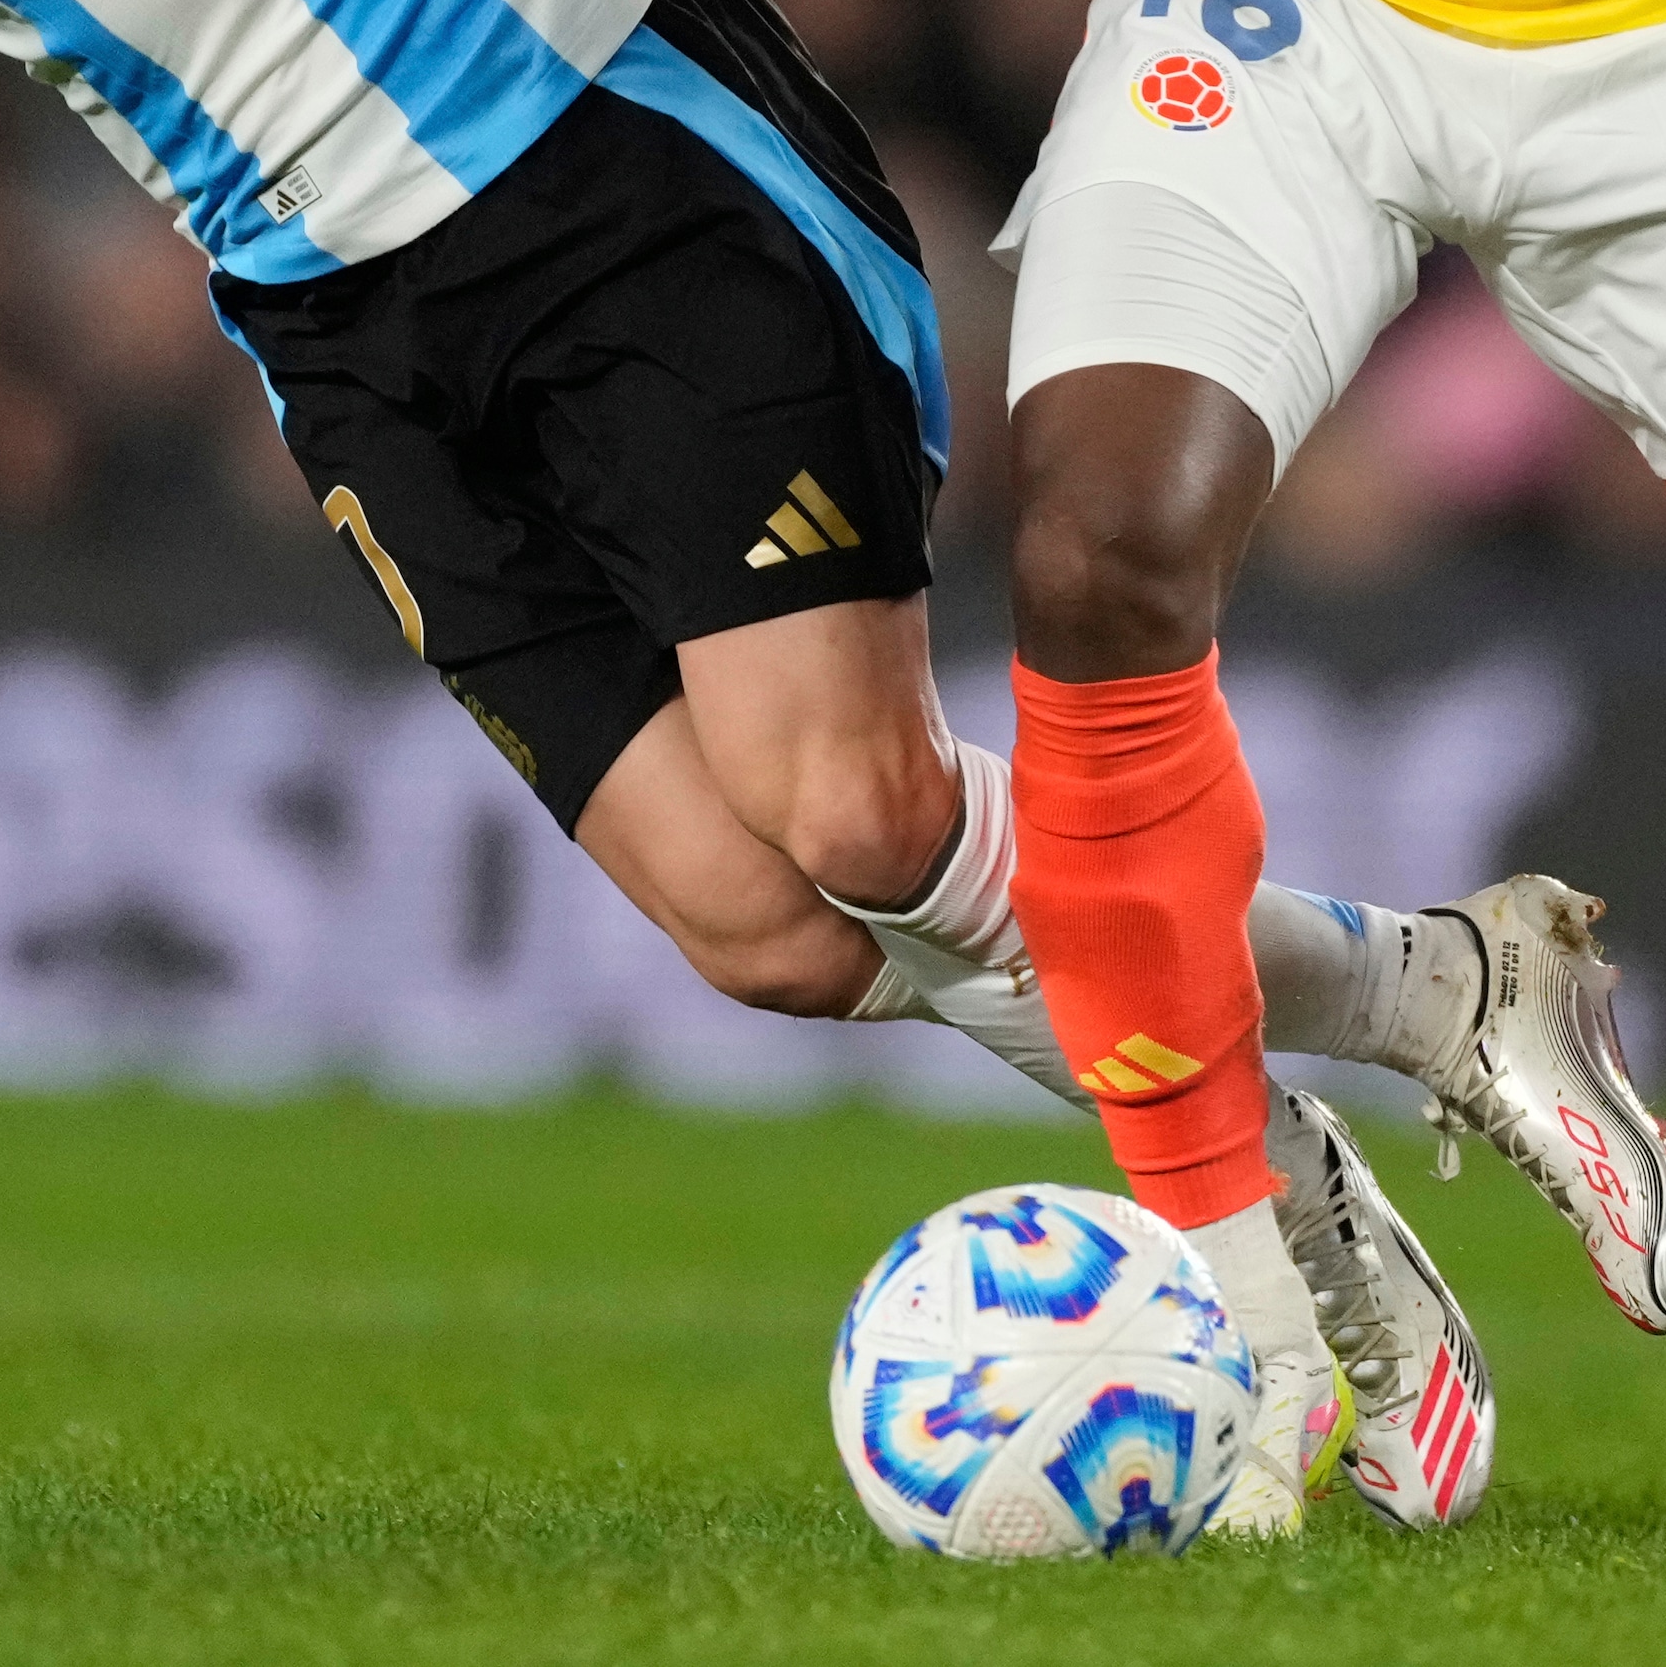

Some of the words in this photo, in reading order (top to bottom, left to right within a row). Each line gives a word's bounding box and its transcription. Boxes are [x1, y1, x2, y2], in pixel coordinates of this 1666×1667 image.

[1498, 975, 1509, 1008] THIAGO
[1508, 977, 1517, 1007] MATEO
[1558, 1105, 1648, 1255] F50
